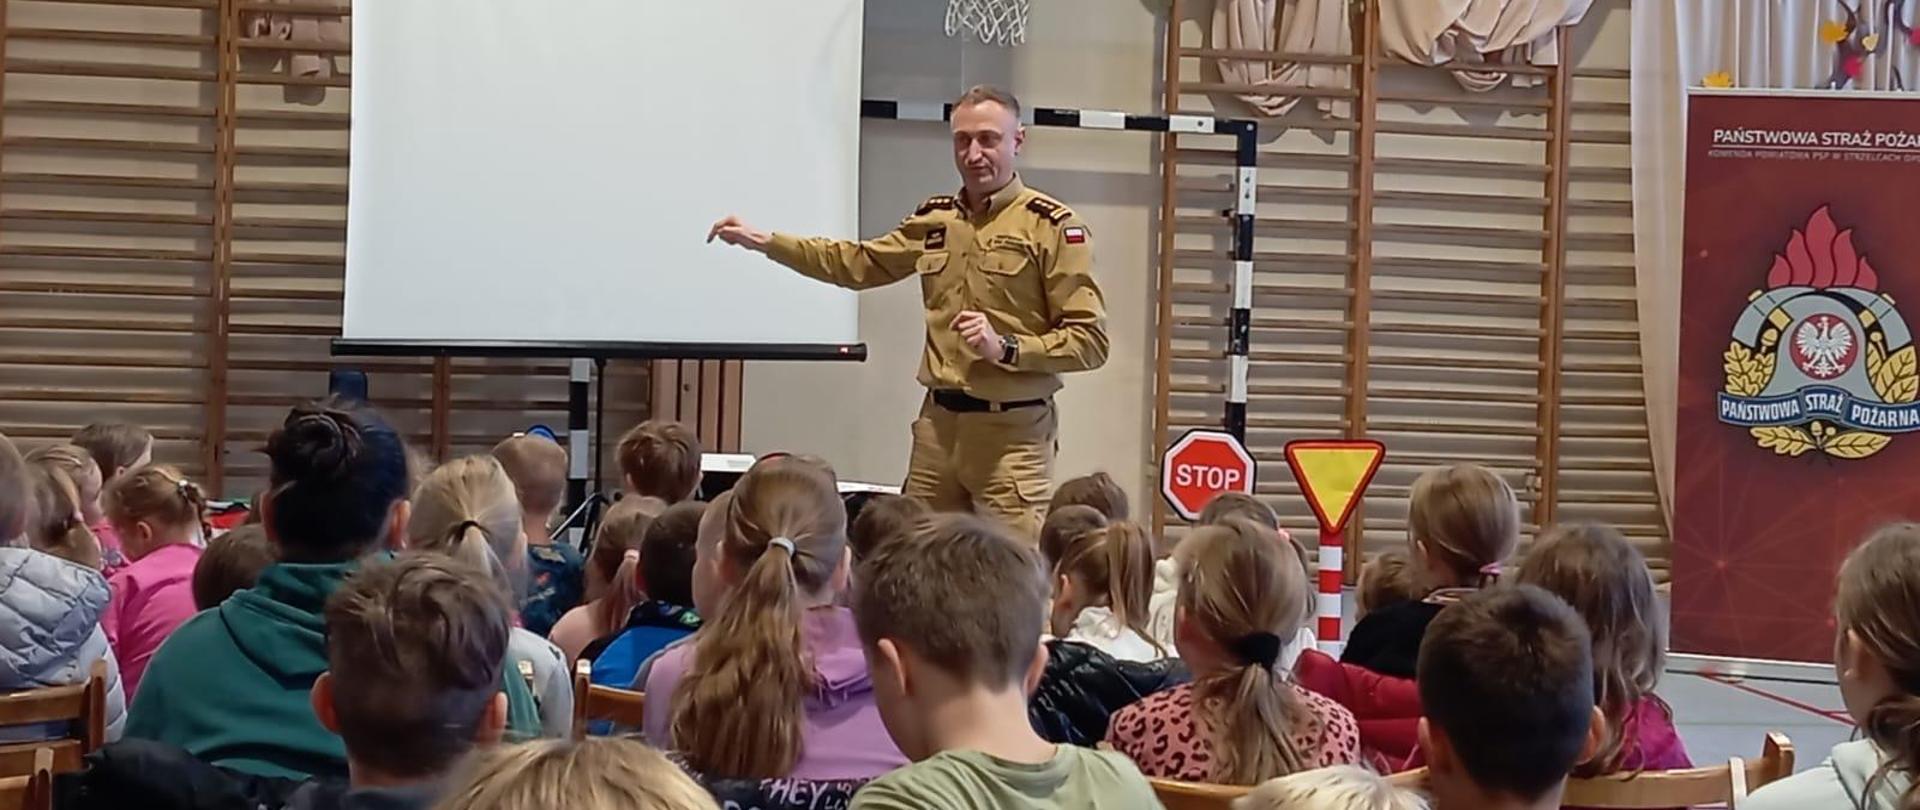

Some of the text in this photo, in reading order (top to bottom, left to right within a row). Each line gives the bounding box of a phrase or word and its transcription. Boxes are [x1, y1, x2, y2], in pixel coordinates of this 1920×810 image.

[1713, 127, 1818, 144] PAŃSTWOWA
[1822, 129, 1872, 146] STRAŻ
[1722, 393, 1920, 427] PAŃSTWOWA STRAŻ POŻARNA
[1176, 463, 1240, 490] STOP
